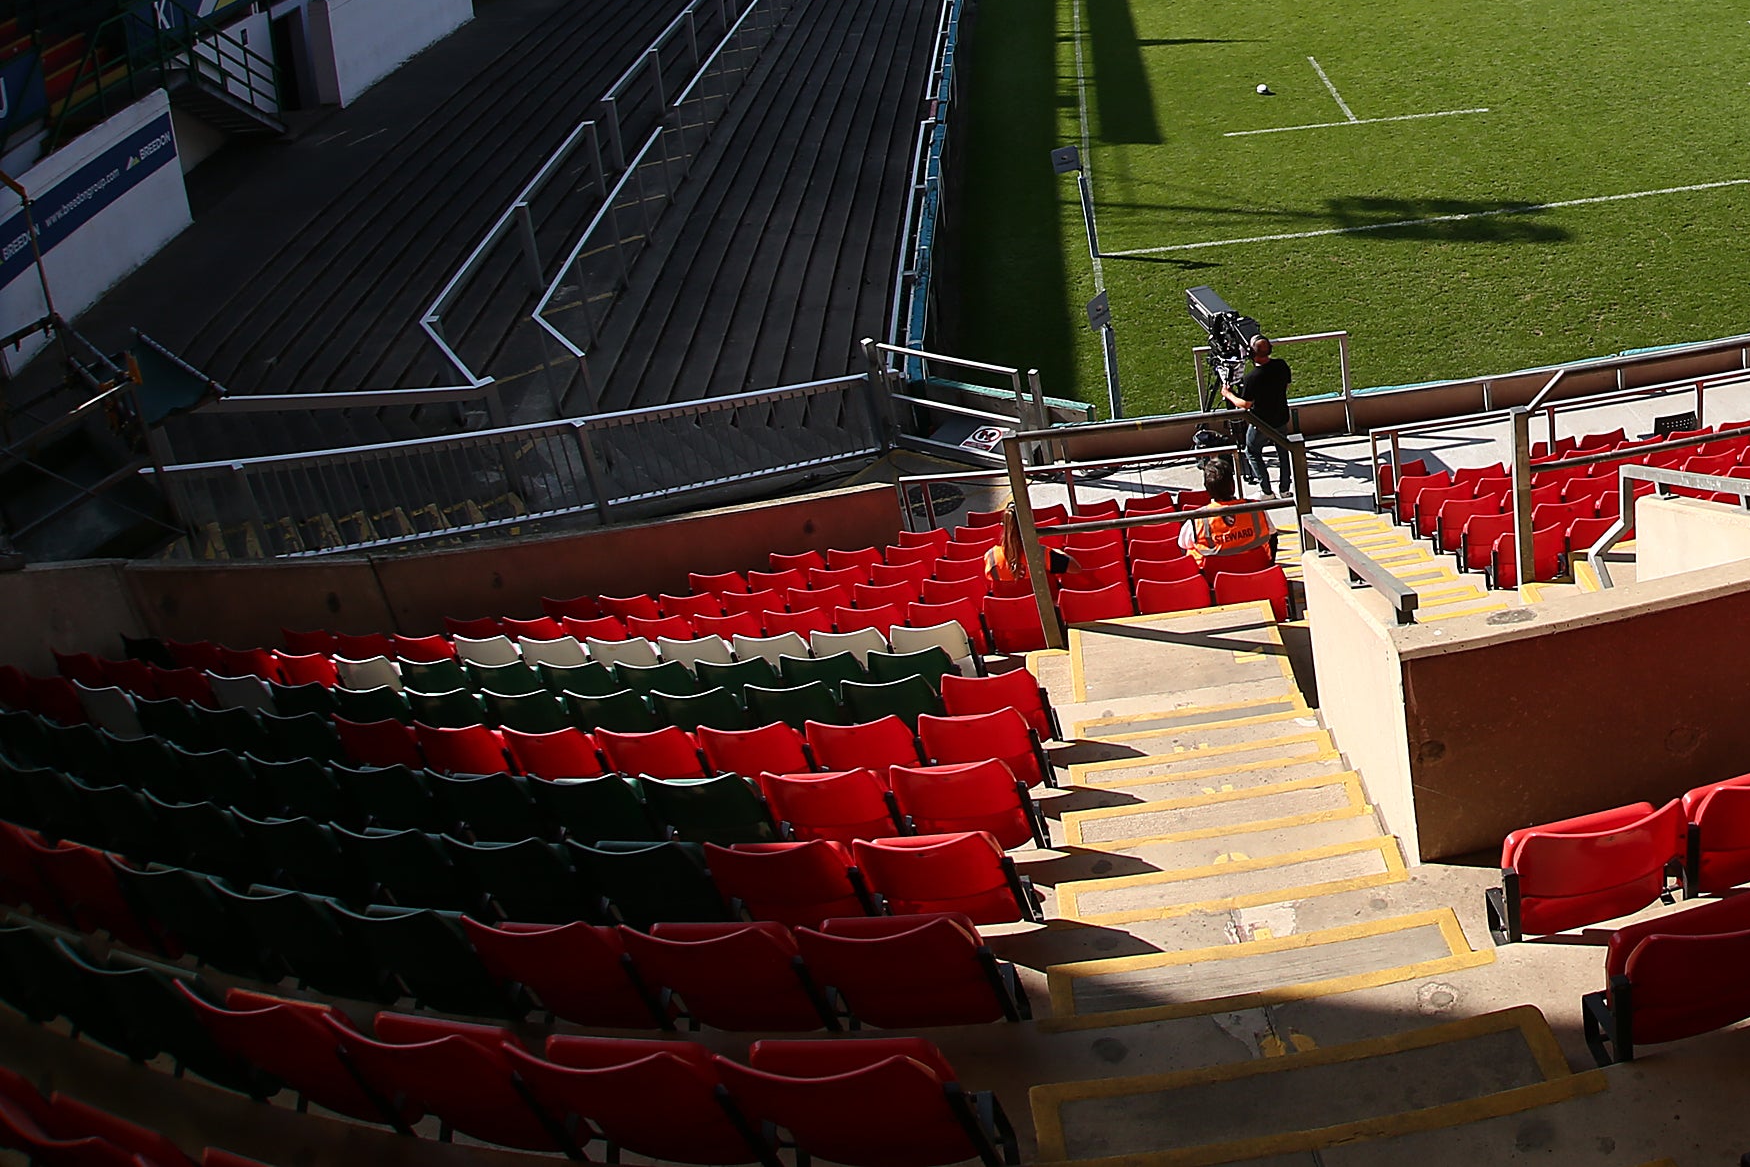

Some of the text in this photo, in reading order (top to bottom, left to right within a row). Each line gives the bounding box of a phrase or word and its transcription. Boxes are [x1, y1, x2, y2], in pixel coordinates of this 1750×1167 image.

[138, 130, 172, 161] BREEDON
[44, 168, 120, 228] www.breedongroup.com
[1215, 528, 1254, 544] STEWARD
